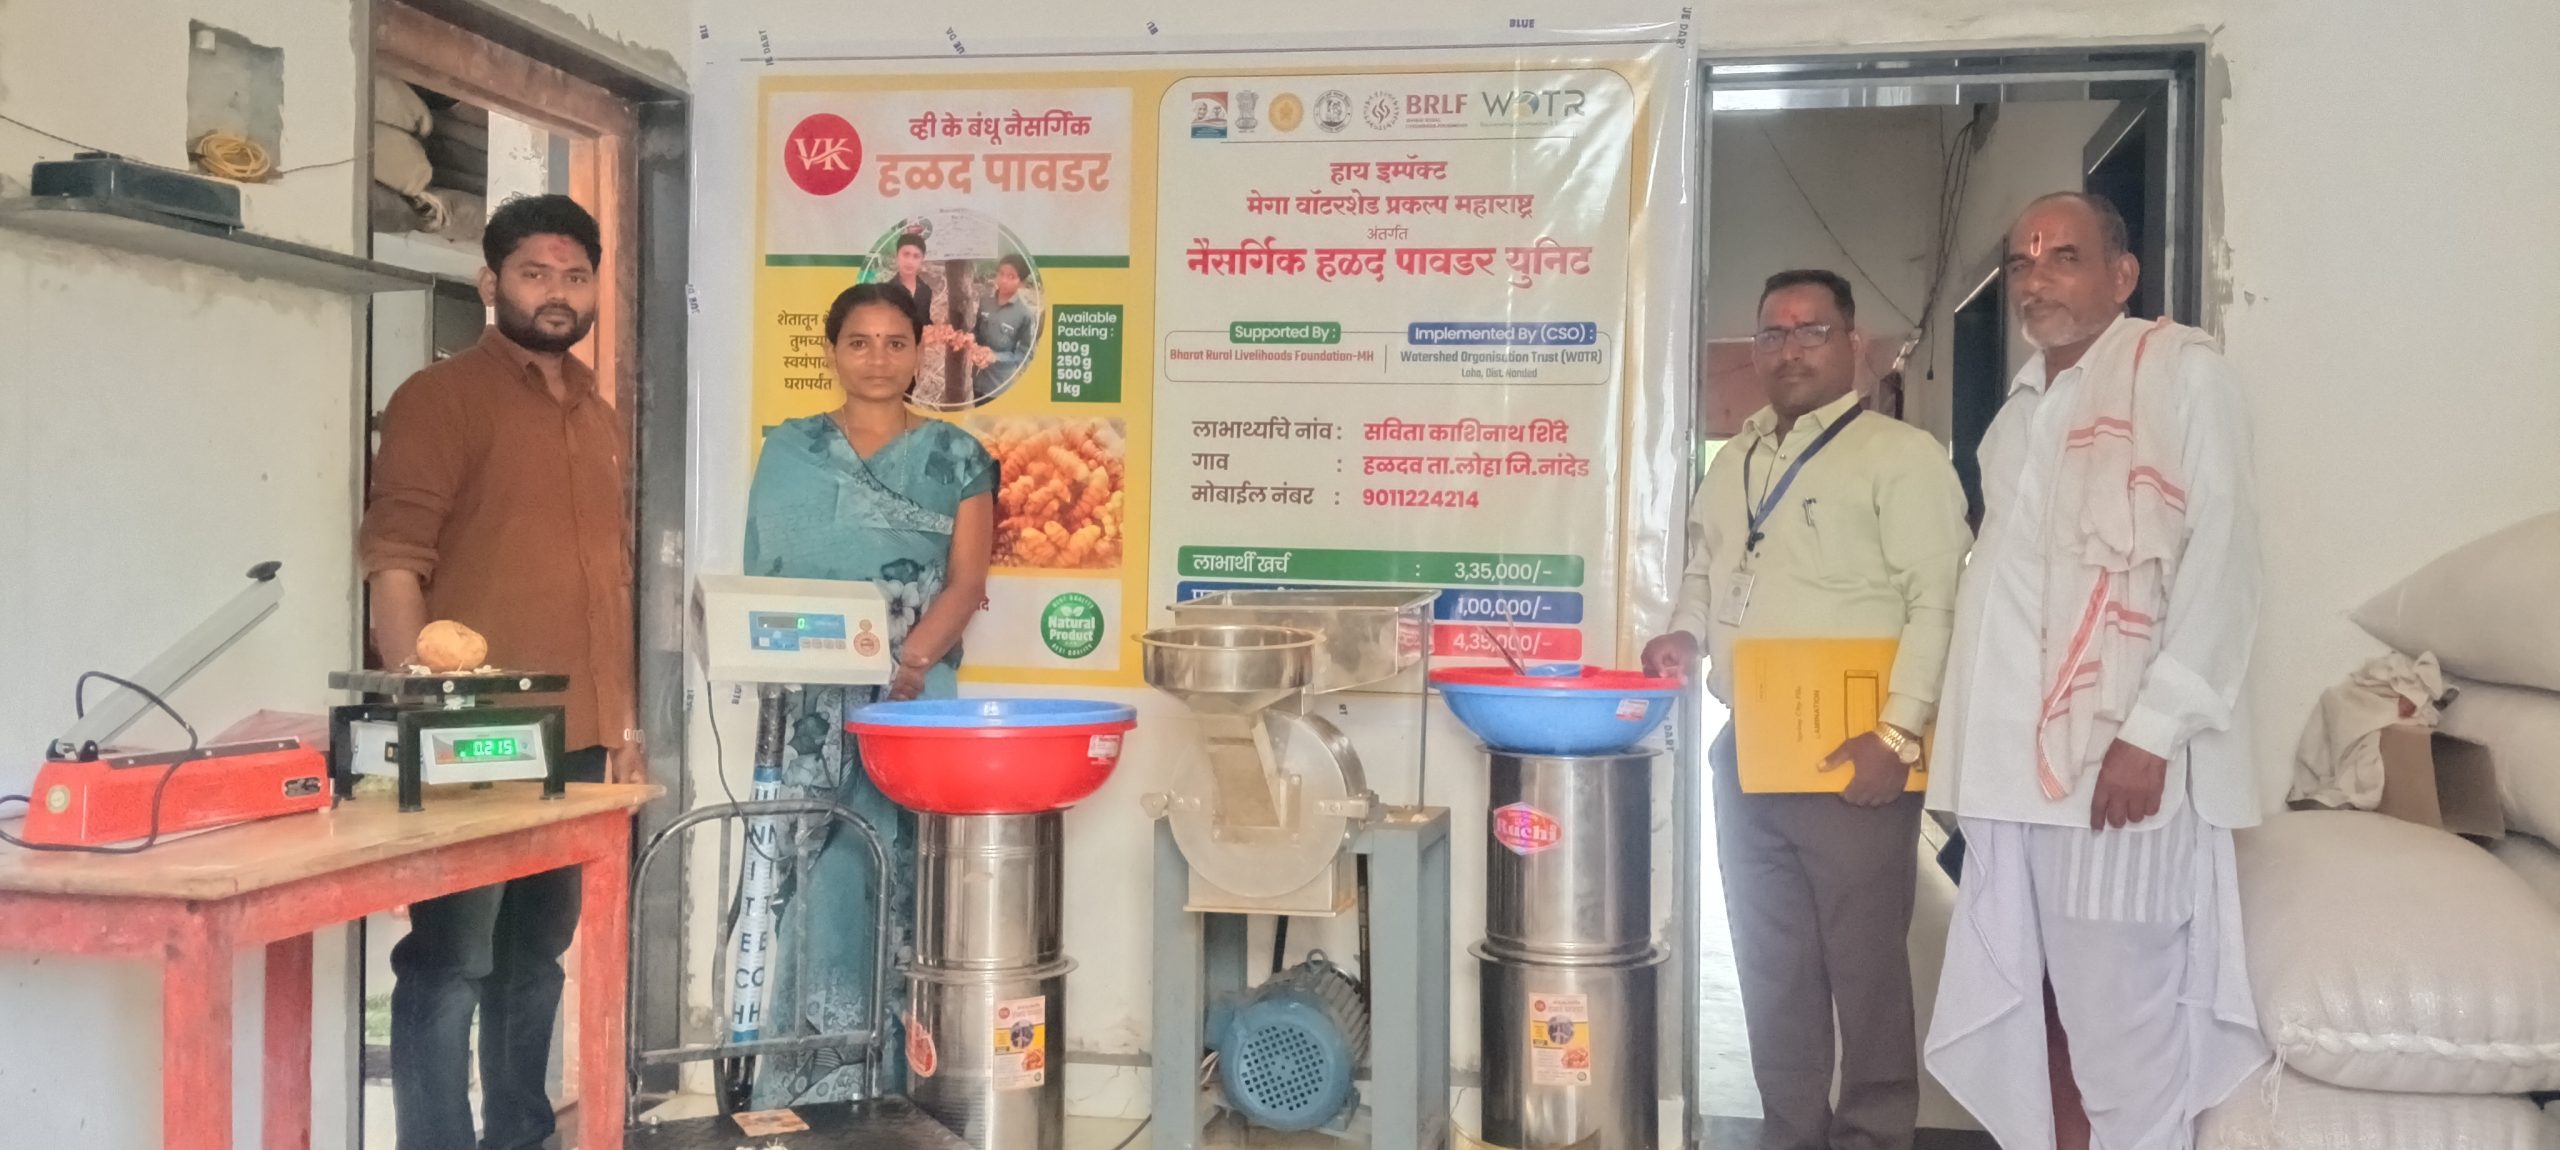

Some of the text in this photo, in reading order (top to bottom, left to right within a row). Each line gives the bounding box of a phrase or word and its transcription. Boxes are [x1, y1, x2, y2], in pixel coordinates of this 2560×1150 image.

[1509, 18, 1535, 29] BLUE
[1406, 94, 1468, 115] BRLF
[909, 109, 1092, 145] व्ही के बंधू नैसर्गिक
[794, 137, 853, 171] VK
[876, 152, 1112, 198] हळद पावडर
[1330, 154, 1448, 185] हाय इम्पॅक्ट
[1246, 189, 1534, 218] मेगा वॉटरशेड प्रकल्प महाराष्ट्र
[1367, 225, 1408, 241] अंतर्गत
[1186, 236, 1592, 289] नैसर्गिक हळद पावडर युनिट
[777, 310, 819, 331] शेतातून
[1058, 312, 1117, 323] Available
[1058, 325, 1108, 340] Packing
[1234, 325, 1309, 342] Supported
[1312, 325, 1330, 342] By
[1415, 326, 1515, 344] Implemented
[1518, 327, 1537, 344] By
[1540, 324, 1585, 343] (CSO)
[1057, 341, 1079, 353] 100
[1170, 349, 1374, 362] Bharat Rural Livelihoods Foundation-MH
[1400, 349, 1603, 365] Watershed Organisation Trust (WOTR)
[1057, 355, 1081, 366] 250
[1057, 368, 1082, 380] 500
[1294, 417, 1334, 440] नांव
[1363, 417, 1426, 442] सविता
[1428, 417, 1526, 443] काशिनाथ
[1191, 452, 1230, 471] गाव
[1362, 456, 1424, 475] हळदव
[1427, 452, 1502, 477] ता.लोहा
[1505, 451, 1590, 477] जि.नांदेड
[1191, 480, 1268, 505] मोबाईल
[1270, 481, 1315, 505] नंबर
[1362, 488, 1480, 508] 9011224214
[1193, 551, 1257, 573] लाभार्थी
[1257, 552, 1292, 573] खर्च
[1454, 560, 1553, 584] 3,35,000/-
[1457, 595, 1553, 620] 1,00,000/-
[797, 618, 805, 629] 0
[1048, 615, 1096, 629] Natural
[1049, 629, 1094, 641] Product
